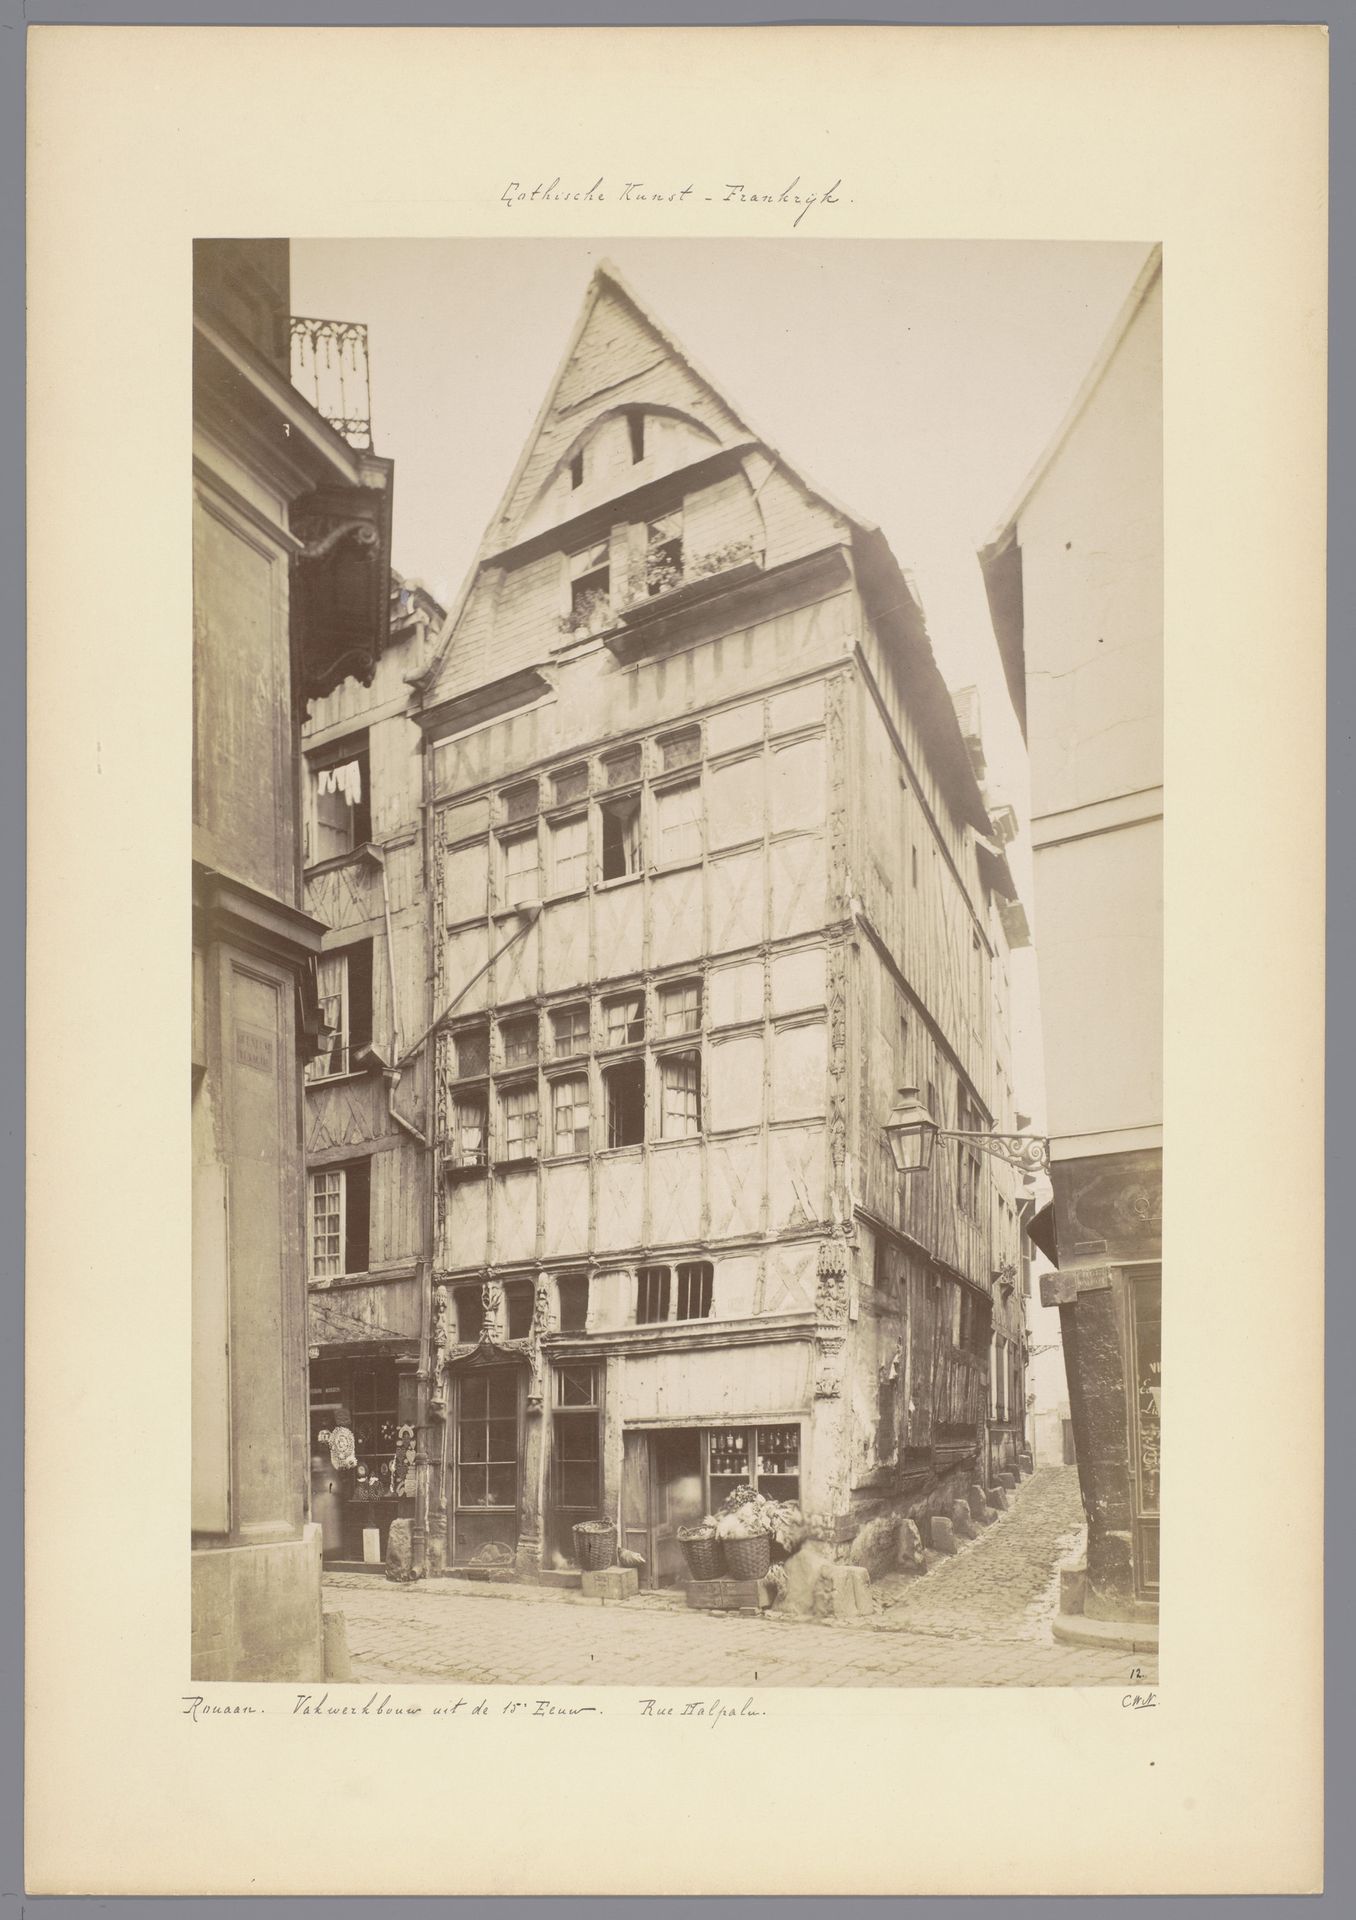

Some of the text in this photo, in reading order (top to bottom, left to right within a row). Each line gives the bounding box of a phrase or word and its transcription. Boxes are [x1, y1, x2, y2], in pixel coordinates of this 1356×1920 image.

[500, 176, 605, 208] Gothische
[619, 182, 694, 202] Kunst
[181, 1695, 265, 1723] Rouaan.
[432, 1697, 468, 1715] uit
[471, 1698, 489, 1716] de
[638, 1699, 673, 1717] Rue
